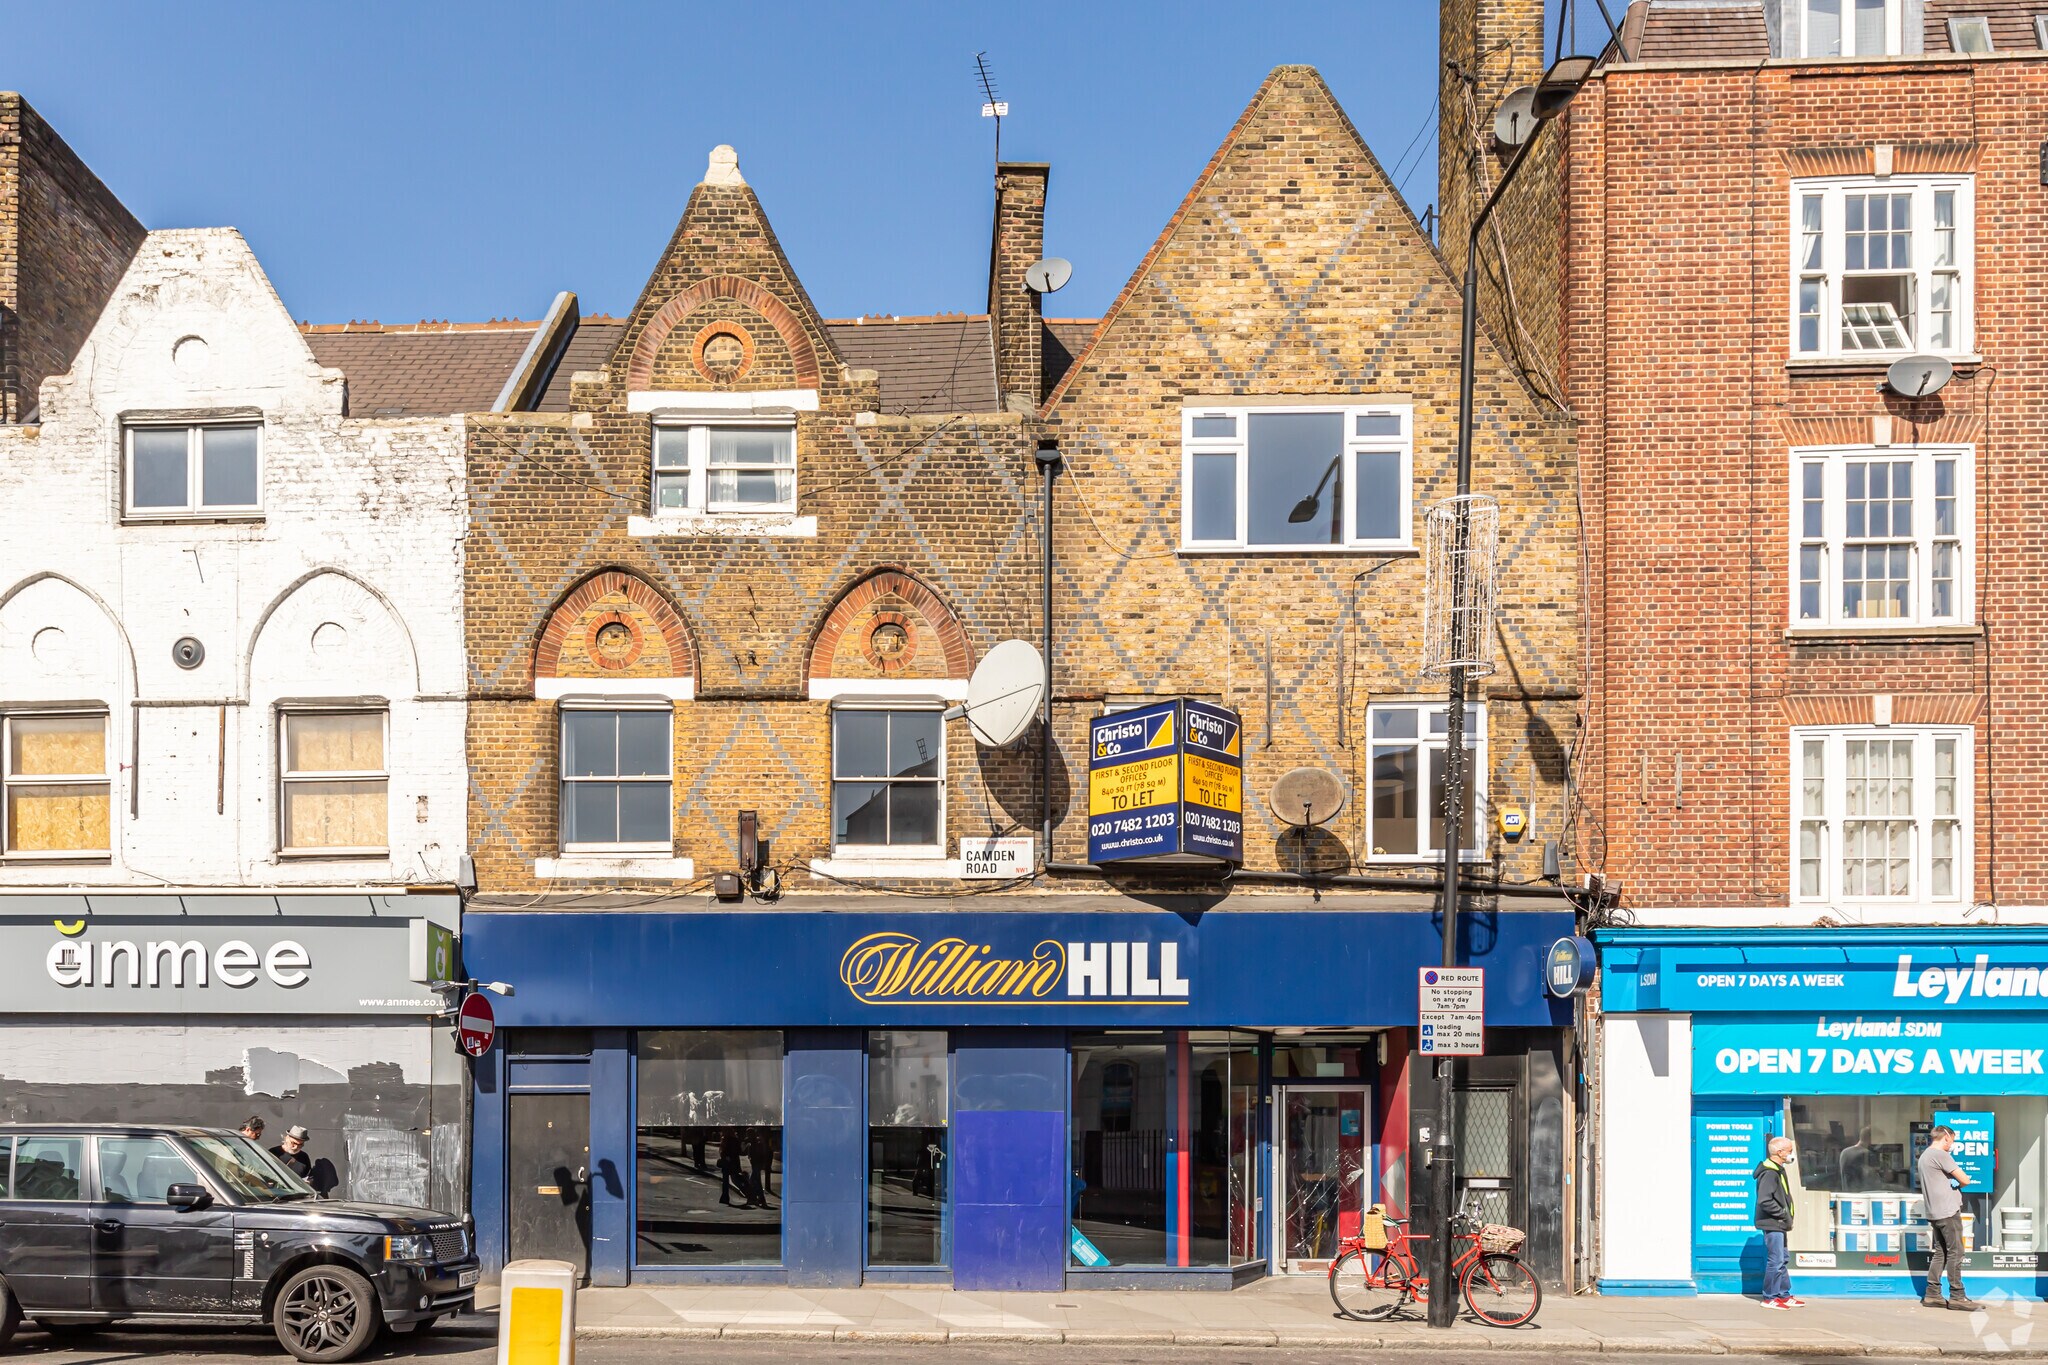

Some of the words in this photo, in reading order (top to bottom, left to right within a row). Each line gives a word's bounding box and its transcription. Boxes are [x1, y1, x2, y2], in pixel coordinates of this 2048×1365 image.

[1189, 713, 1222, 735] Christo
[1097, 723, 1142, 743] Christo
[1190, 729, 1208, 745] &Co
[1097, 743, 1121, 756] &Co
[1095, 768, 1113, 779] FIRST
[1122, 764, 1149, 775] SECOND
[1151, 758, 1172, 769] FLOOR
[1188, 757, 1201, 767] FIRST
[1207, 761, 1224, 773] SECOND
[1225, 766, 1238, 776] FLOOR
[1120, 772, 1147, 783] OFFICES
[1205, 771, 1222, 781] OFFICES
[1102, 787, 1114, 796] 840
[1134, 781, 1144, 791] (78
[1158, 777, 1166, 787] M)
[1112, 795, 1127, 810] TO
[1133, 790, 1154, 806] LET
[1200, 789, 1211, 804] TO
[1213, 792, 1227, 807] LET
[1092, 822, 1111, 836] 020
[1114, 818, 1142, 832] 7482
[1146, 813, 1174, 828] 1203
[1185, 812, 1200, 825] 020
[1202, 814, 1220, 829] 7482
[1222, 818, 1240, 833] 1203
[1505, 815, 1519, 824] ADT
[1102, 834, 1163, 850] www.christo.co.uk
[1193, 834, 1234, 848] www.christo.co.uk
[966, 850, 1015, 861] CAMDEN
[966, 863, 997, 873] ROAD
[840, 931, 1066, 1001] William
[1067, 942, 1189, 996] HILL
[1554, 965, 1573, 985] HILL
[1640, 973, 1657, 986] LSDM
[1697, 975, 1735, 987] OPEN
[1738, 975, 1748, 987] 7
[1750, 975, 1787, 987] DAYS
[1789, 975, 1800, 987] A
[1804, 974, 1844, 986] WEEK
[359, 997, 451, 1006] www.anmee.co.uk
[1716, 1048, 1801, 1073] OPEN
[1808, 1049, 1826, 1073] 7
[1833, 1049, 1914, 1073] DAYS
[1920, 1049, 1944, 1073] A
[1950, 1049, 2044, 1074] WEEK
[1963, 1131, 1989, 1140] ARE
[1953, 1142, 1988, 1156] PEN
[1864, 1254, 1900, 1264] Leyland
